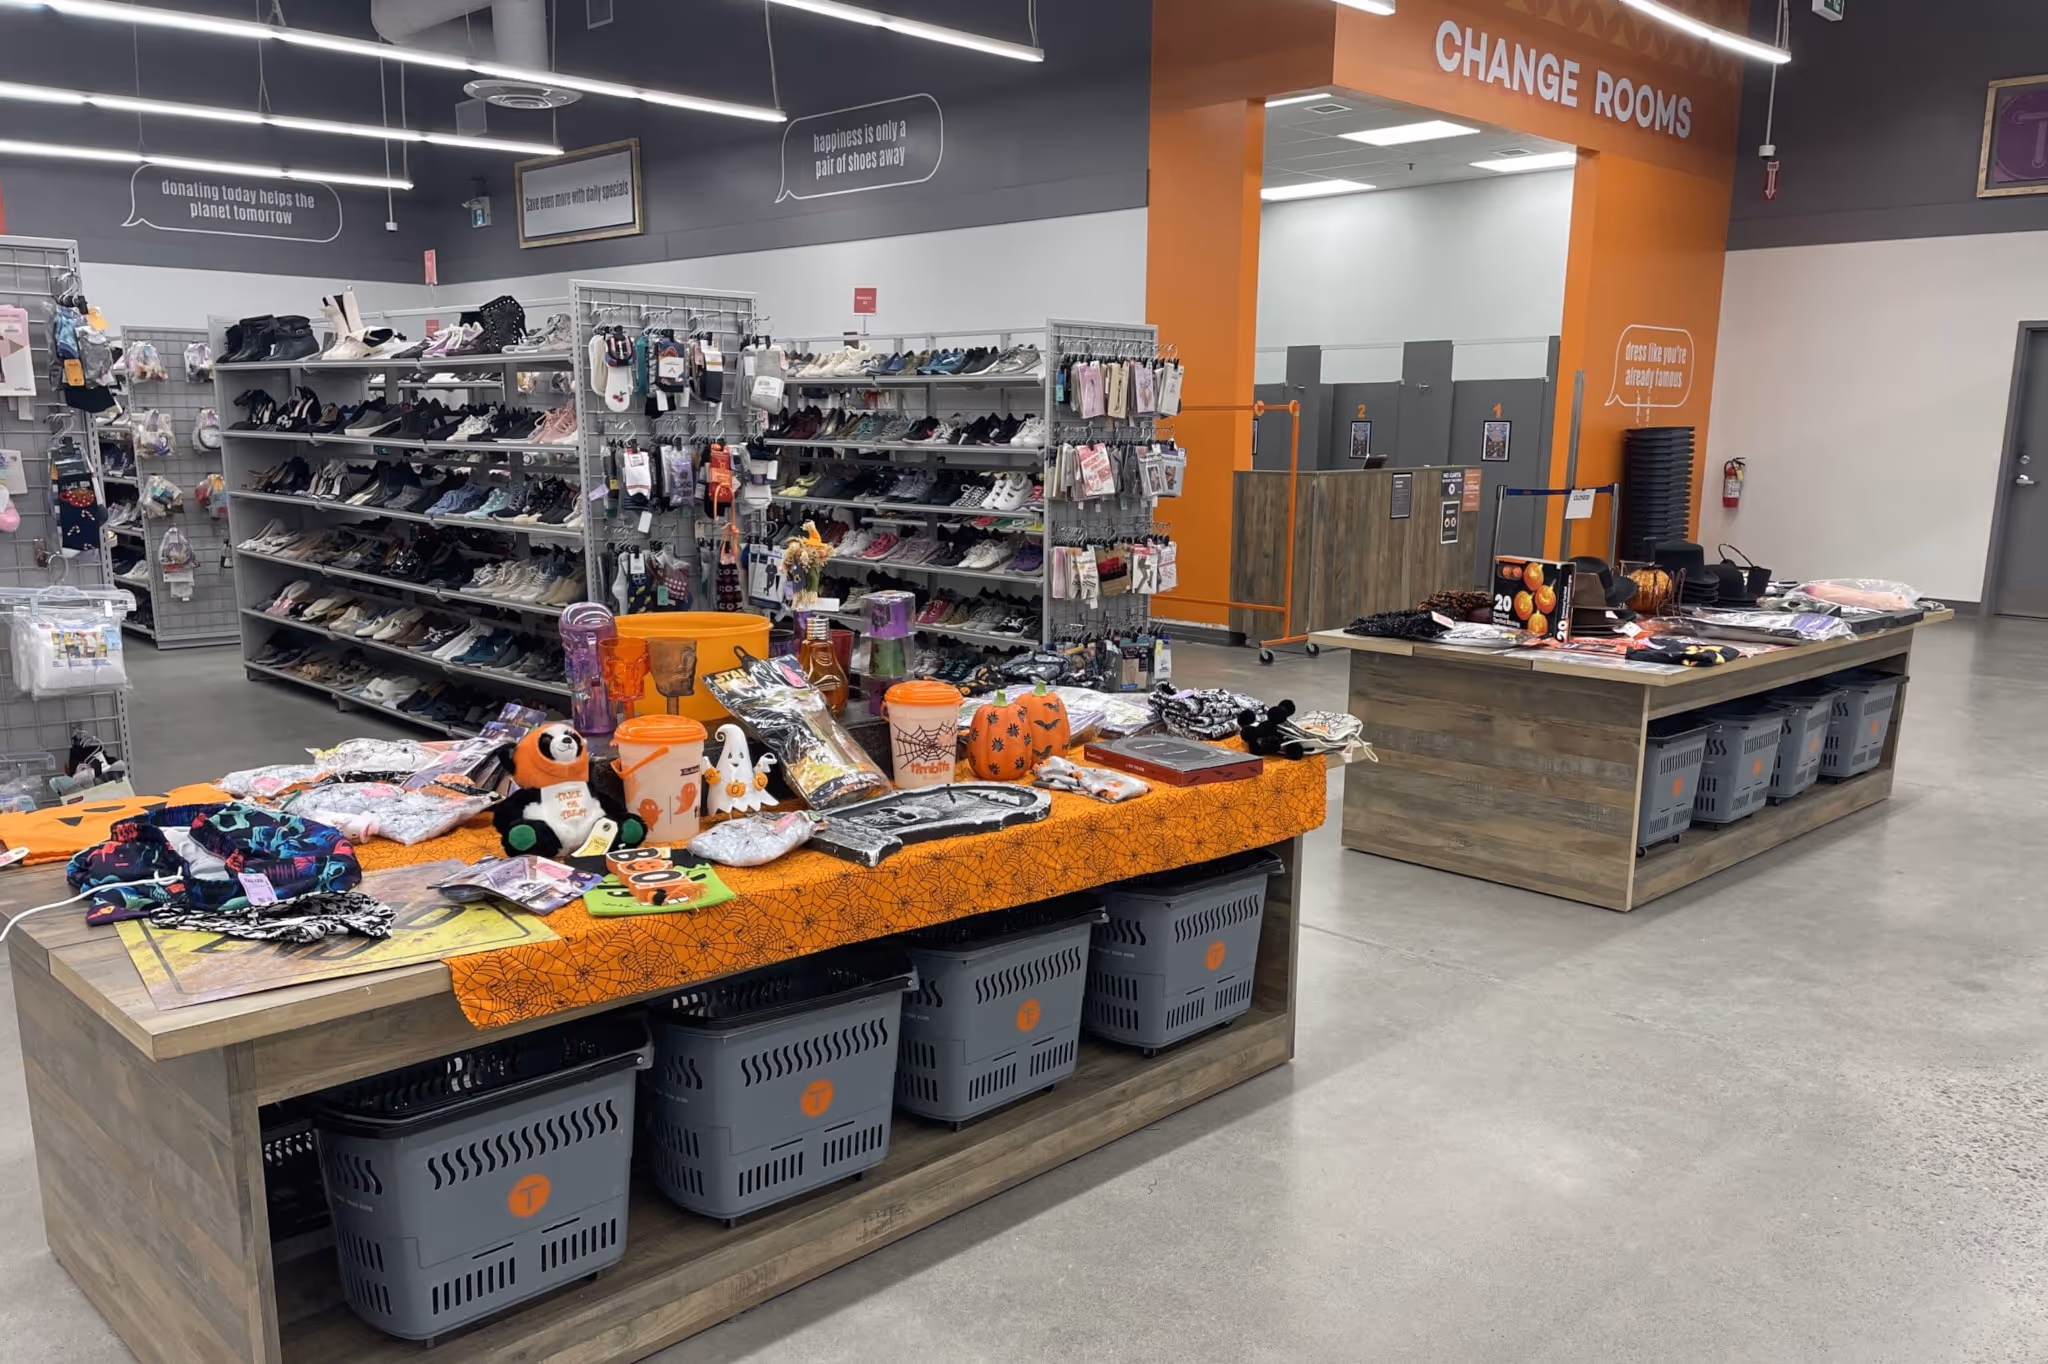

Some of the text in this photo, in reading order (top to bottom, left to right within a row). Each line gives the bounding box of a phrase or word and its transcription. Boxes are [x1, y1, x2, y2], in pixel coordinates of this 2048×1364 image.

[1435, 20, 1692, 138] CHANGE ROOMS
[813, 120, 906, 154] happiness is only a
[815, 146, 906, 180] pair of shoes away
[161, 179, 315, 209] donating today helps the
[525, 180, 629, 212] Save even more with daily specials
[190, 201, 292, 224] planet tomorrow
[1625, 341, 1687, 366] dress like you're
[1625, 366, 1683, 389] already famous
[1357, 402, 1367, 418] 2
[1493, 403, 1503, 418] 1
[1493, 593, 1512, 612] 20
[1556, 620, 1568, 643] 20
[911, 760, 950, 774] timbits
